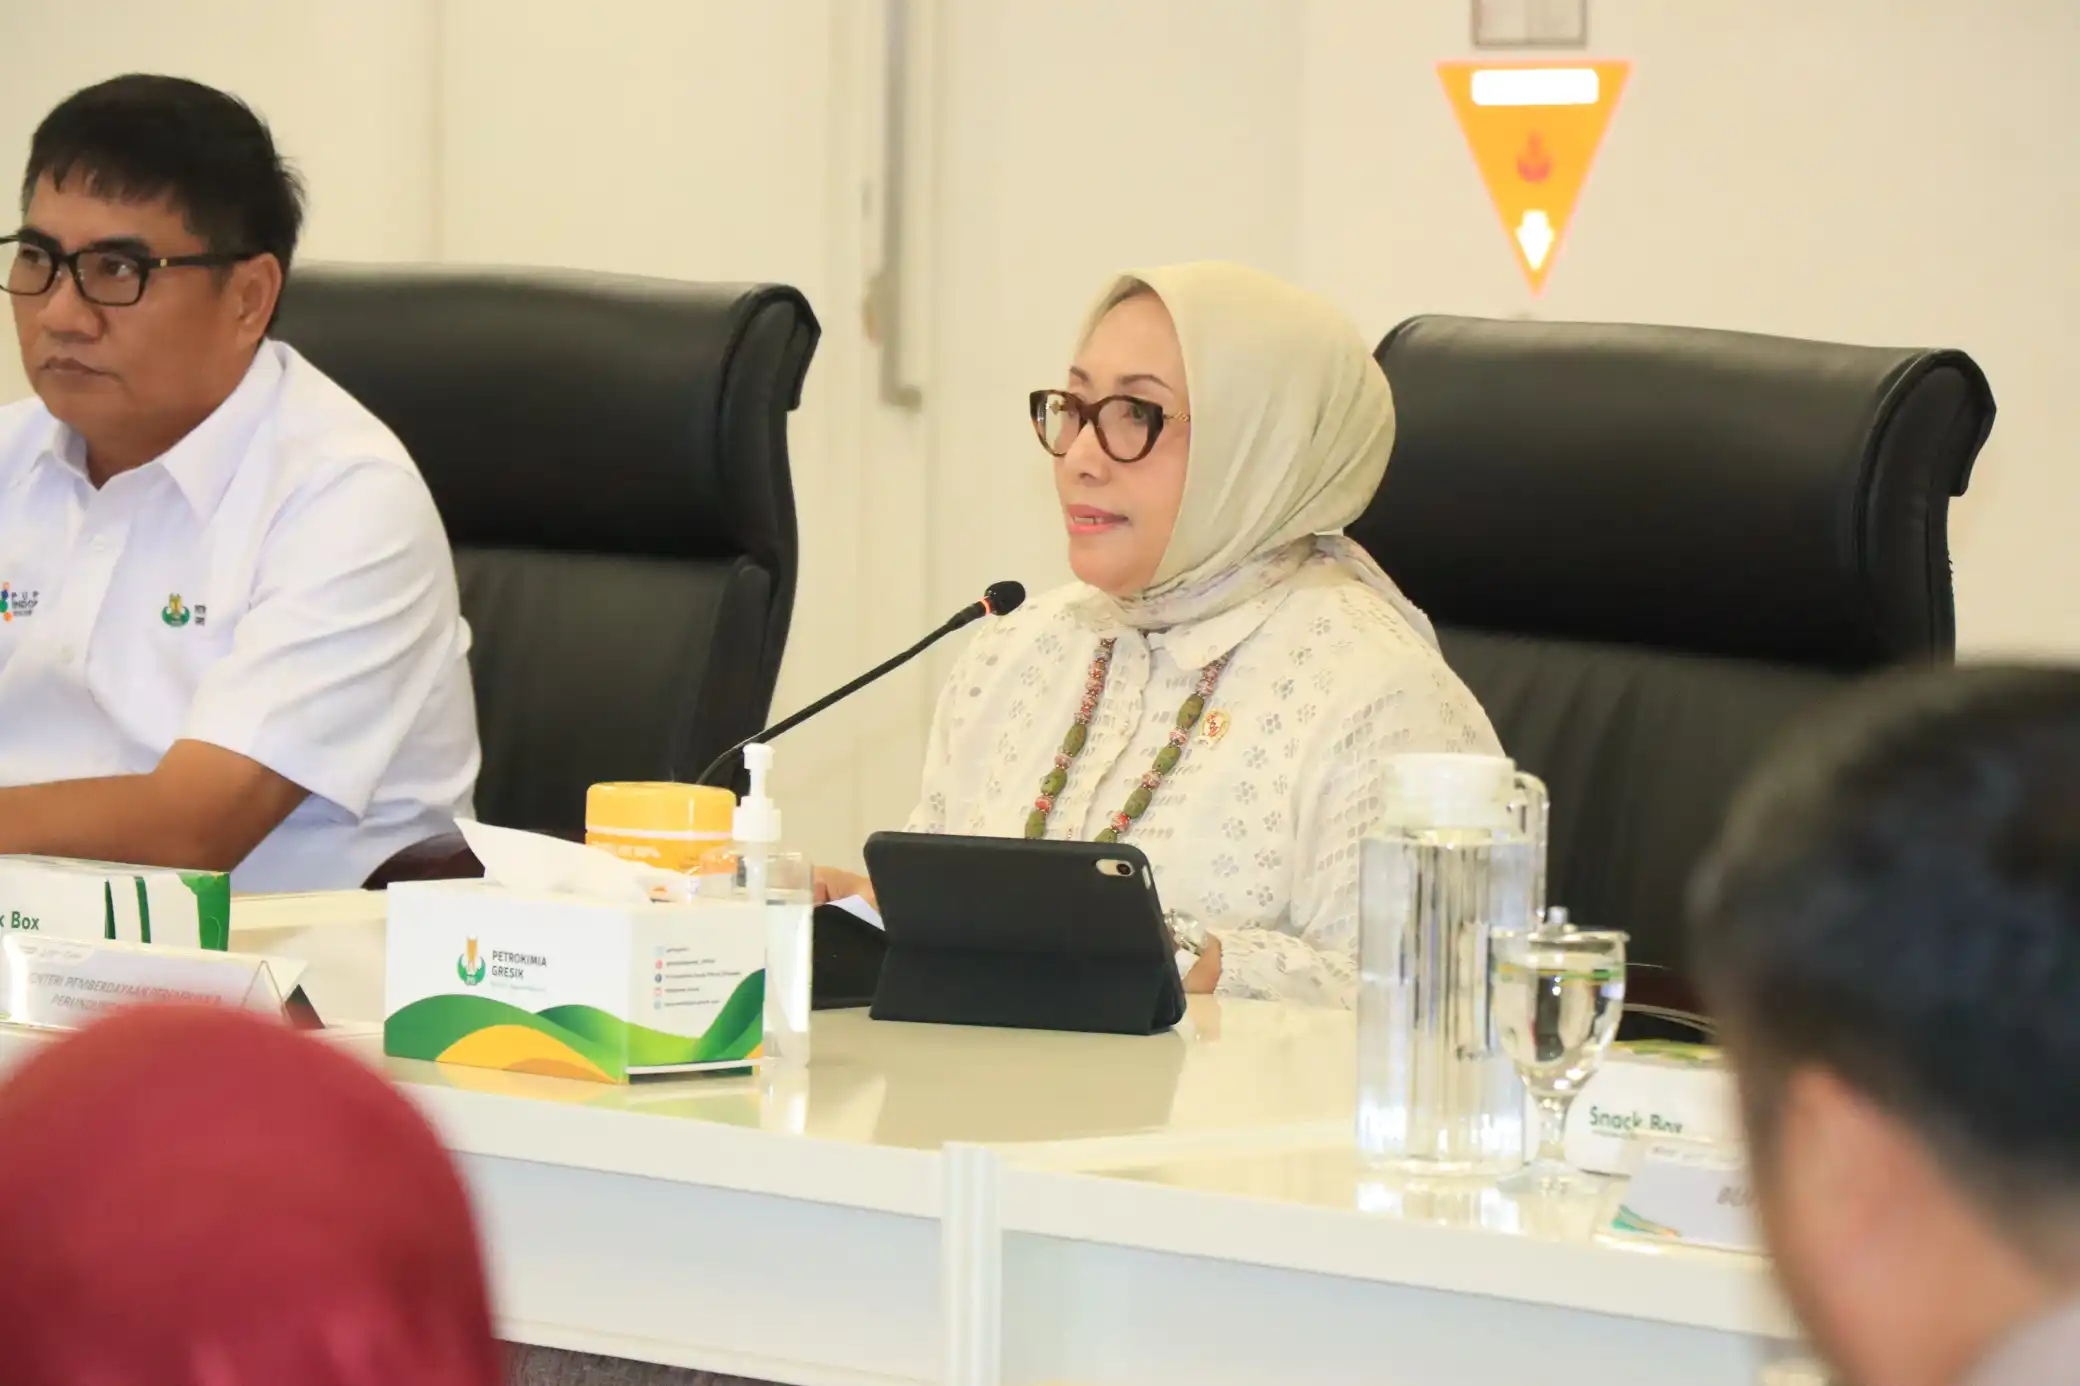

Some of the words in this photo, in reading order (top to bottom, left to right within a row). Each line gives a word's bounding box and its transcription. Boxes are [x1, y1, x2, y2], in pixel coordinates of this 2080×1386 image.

[11, 910, 39, 930] Box
[492, 950, 548, 967] PETROKIMIA
[28, 971, 65, 987] ENTERI
[491, 965, 524, 980] GRESIK
[1589, 1106, 1643, 1129] Snack
